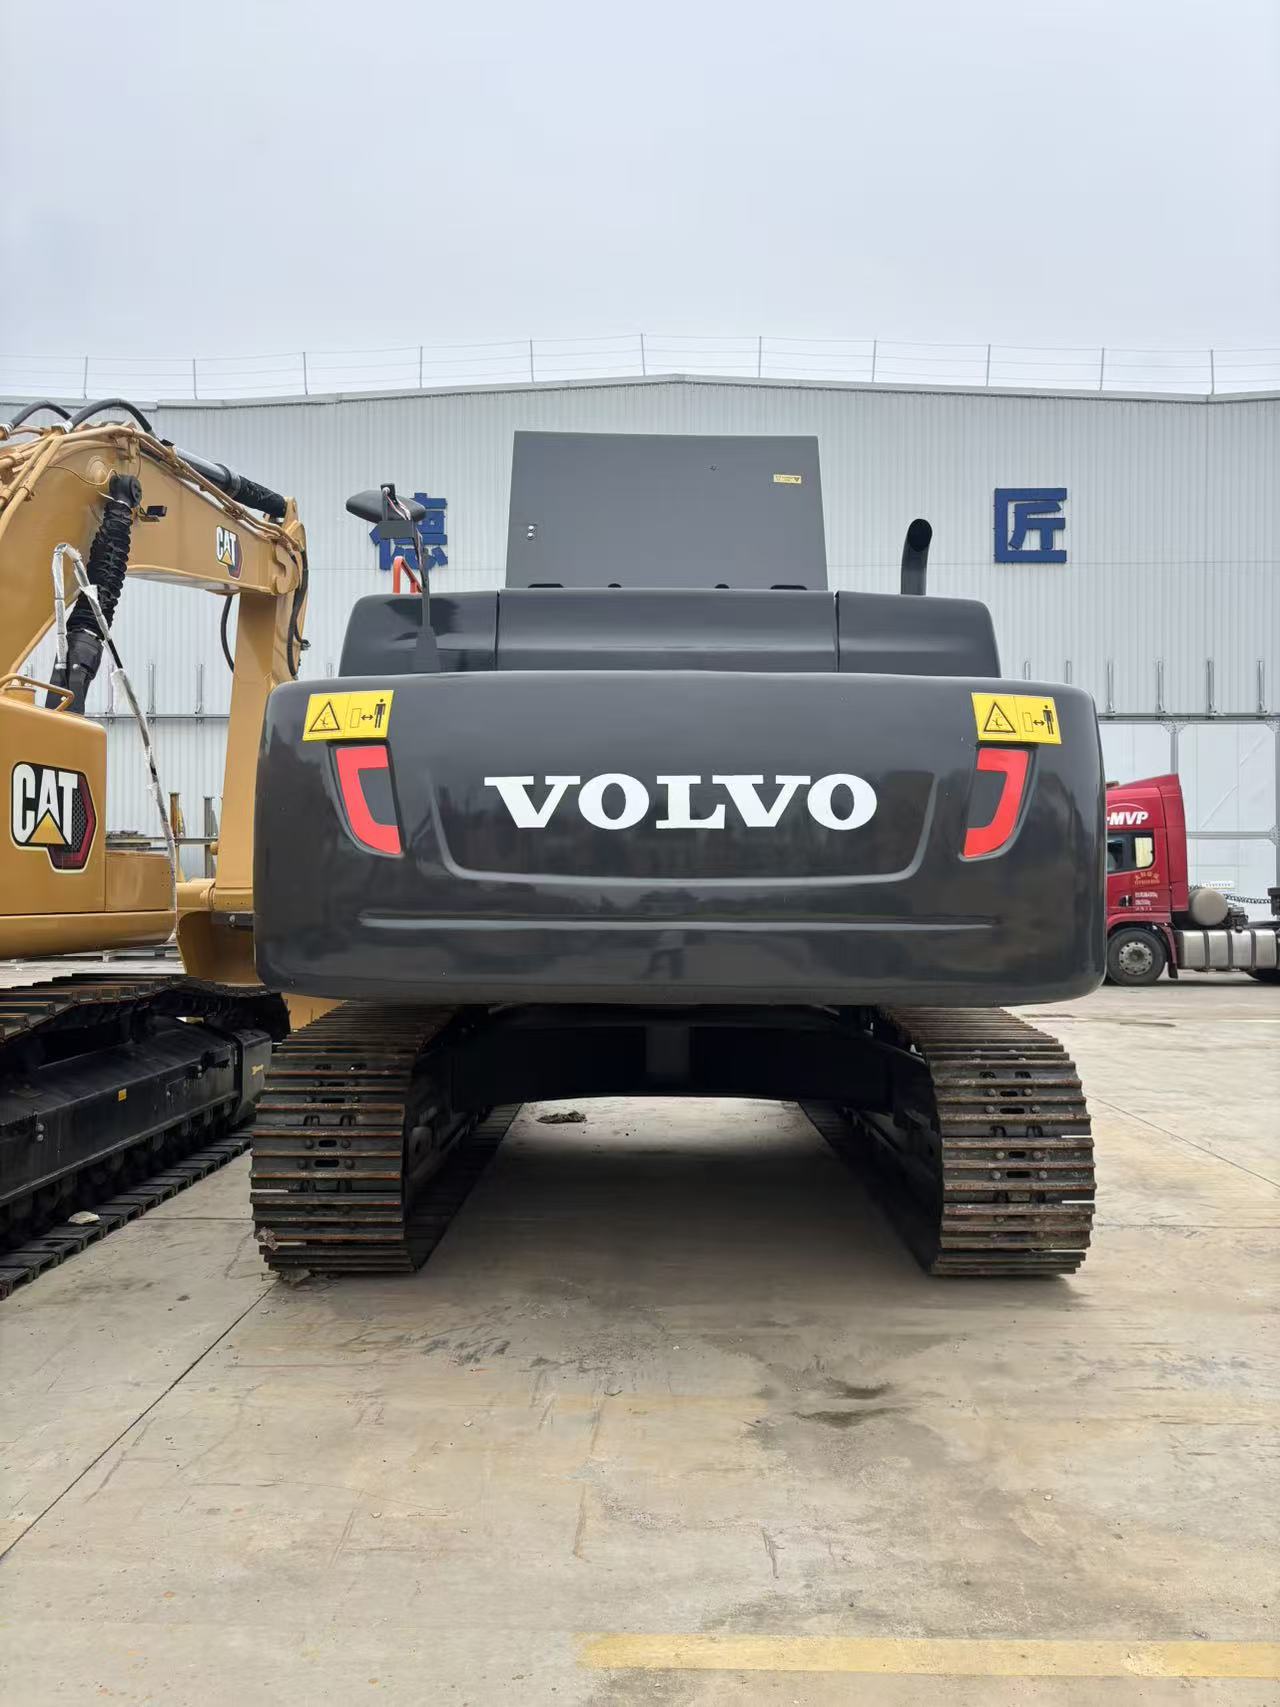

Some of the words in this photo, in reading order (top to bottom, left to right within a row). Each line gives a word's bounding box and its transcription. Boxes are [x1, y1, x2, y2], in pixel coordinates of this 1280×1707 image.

[217, 526, 236, 566] CAT
[994, 488, 1067, 563] 匠
[13, 764, 78, 845] CAT
[484, 773, 877, 830] VOLVO
